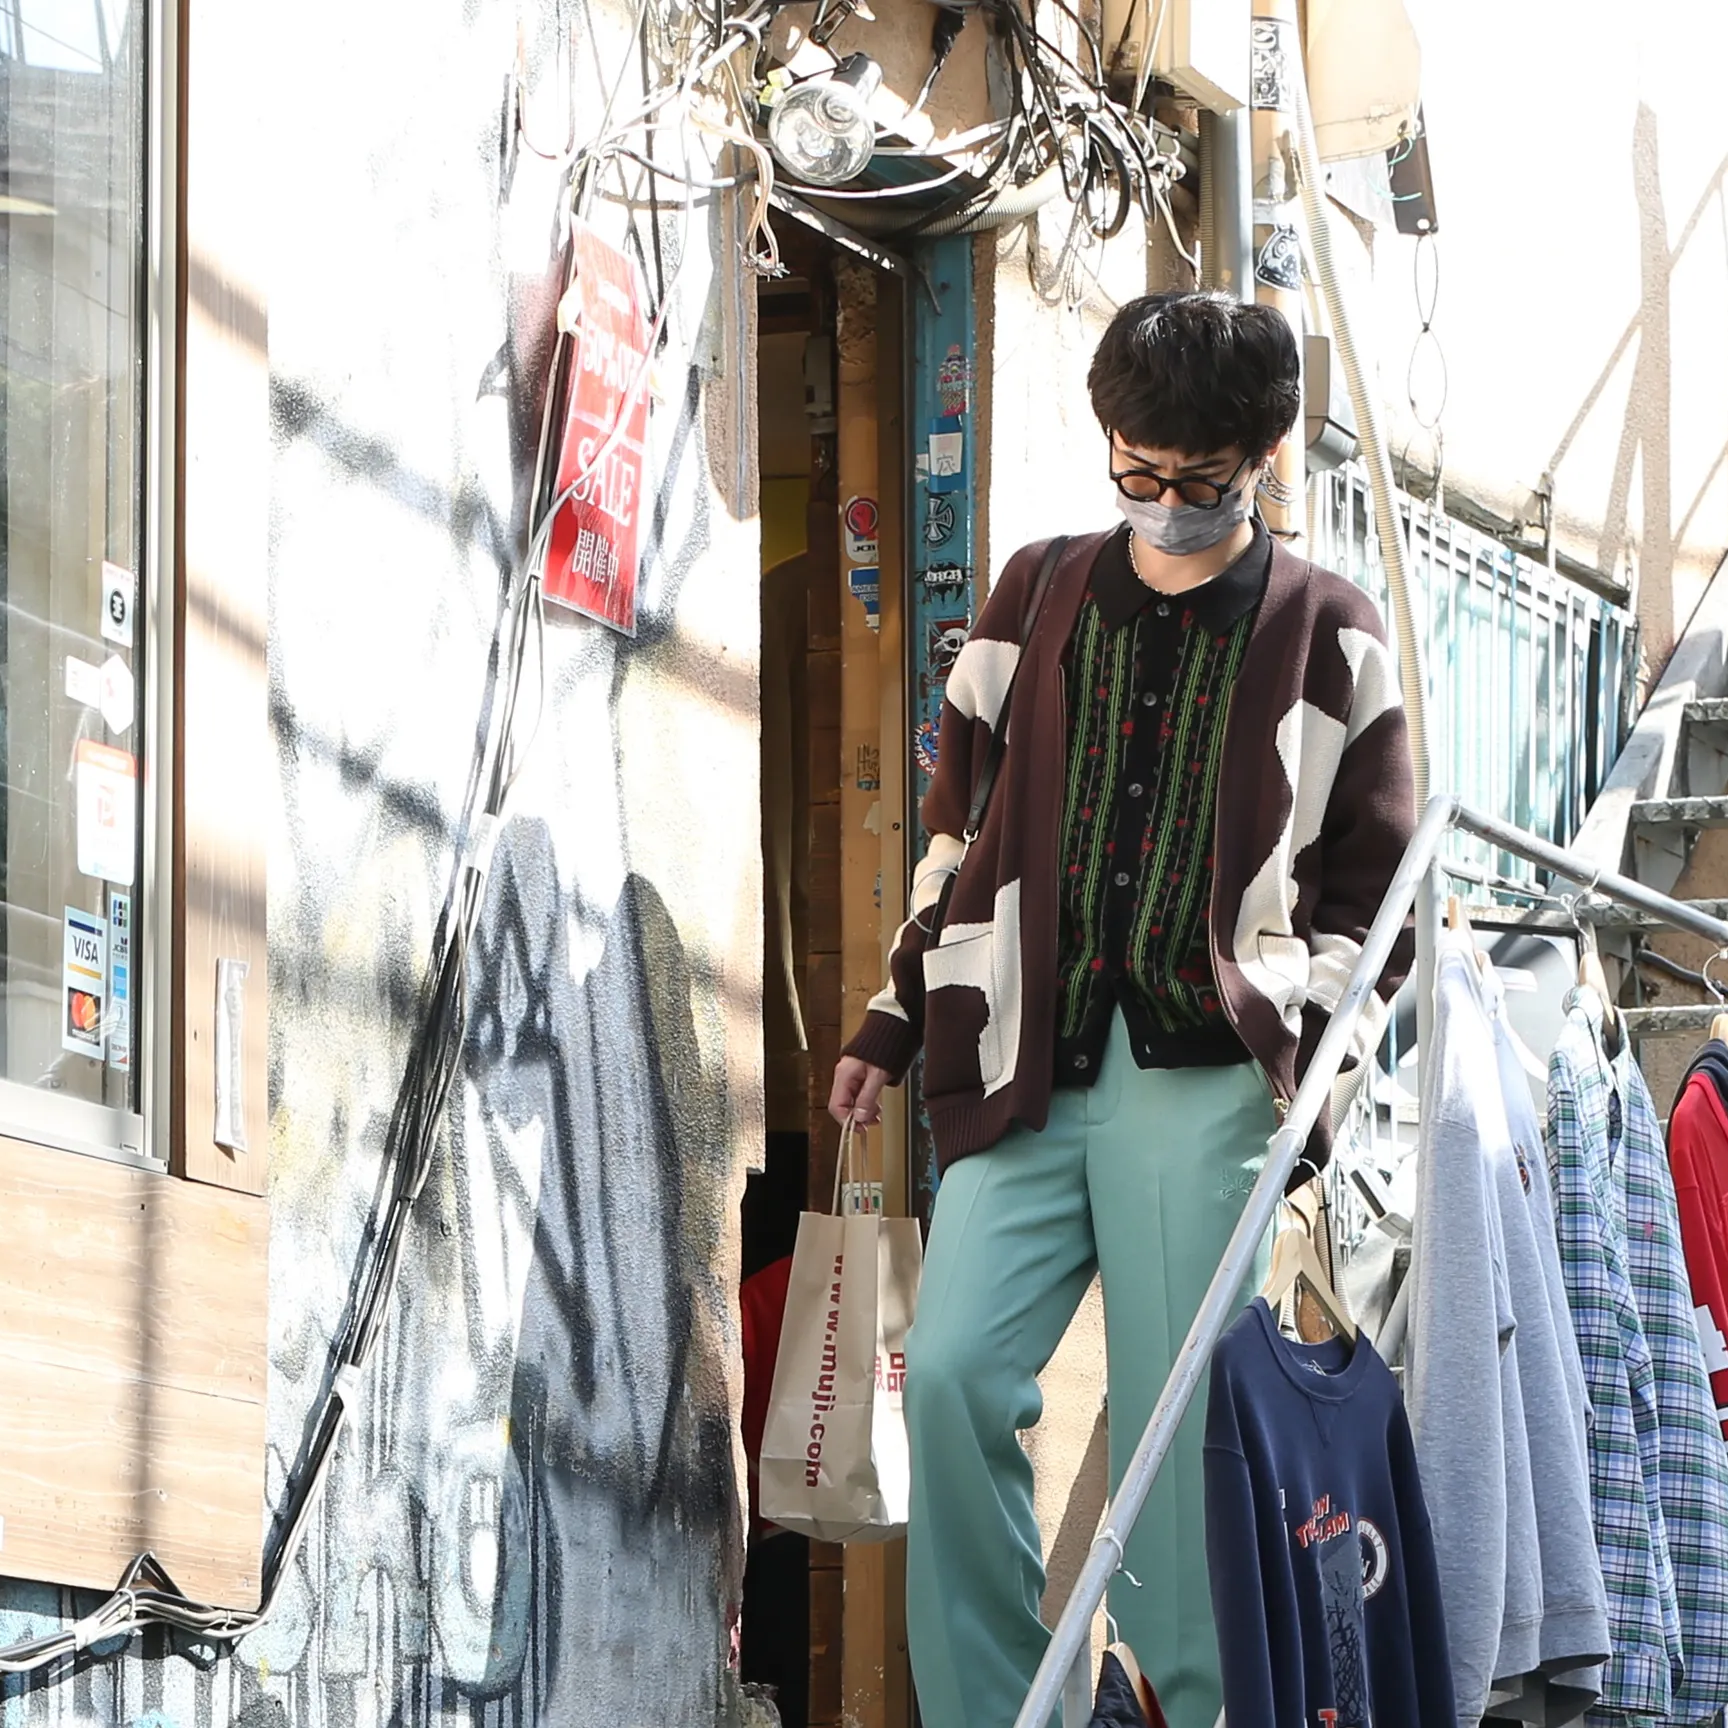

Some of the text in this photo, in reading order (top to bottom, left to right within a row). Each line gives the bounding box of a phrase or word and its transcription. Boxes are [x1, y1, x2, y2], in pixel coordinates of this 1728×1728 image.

[573, 437, 635, 527] SALE
[572, 527, 619, 588] 開催中
[72, 935, 99, 965] VISA
[805, 1254, 844, 1488] www.muji.com
